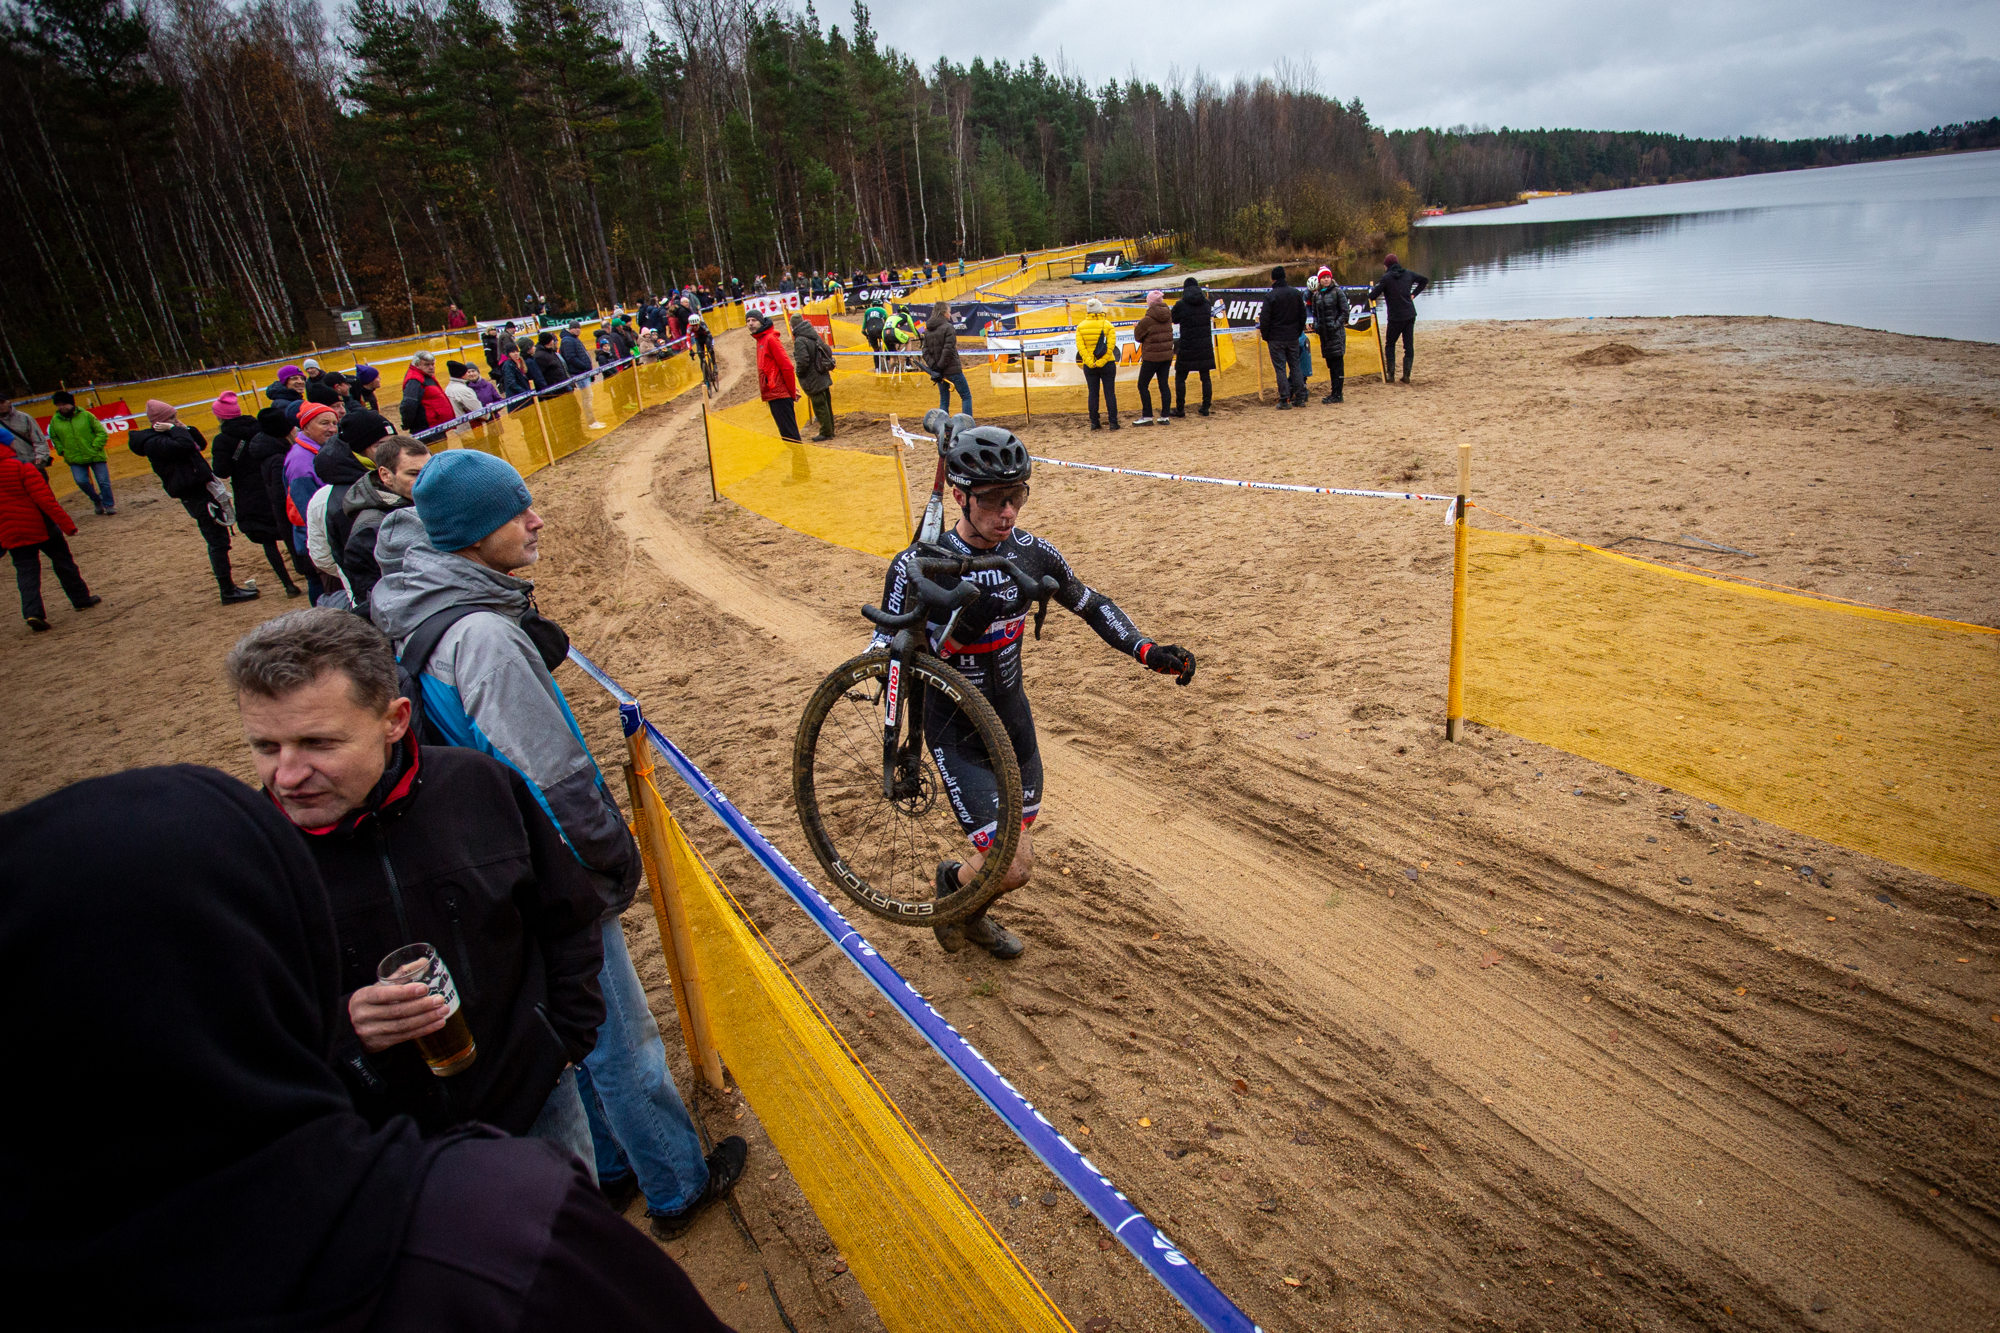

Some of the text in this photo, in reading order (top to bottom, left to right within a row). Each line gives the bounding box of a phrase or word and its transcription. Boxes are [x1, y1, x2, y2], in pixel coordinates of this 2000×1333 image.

[1227, 300, 1263, 321] HI-TE
[934, 747, 975, 825] Ethanol Energy
[831, 860, 934, 916] EQUATOR
